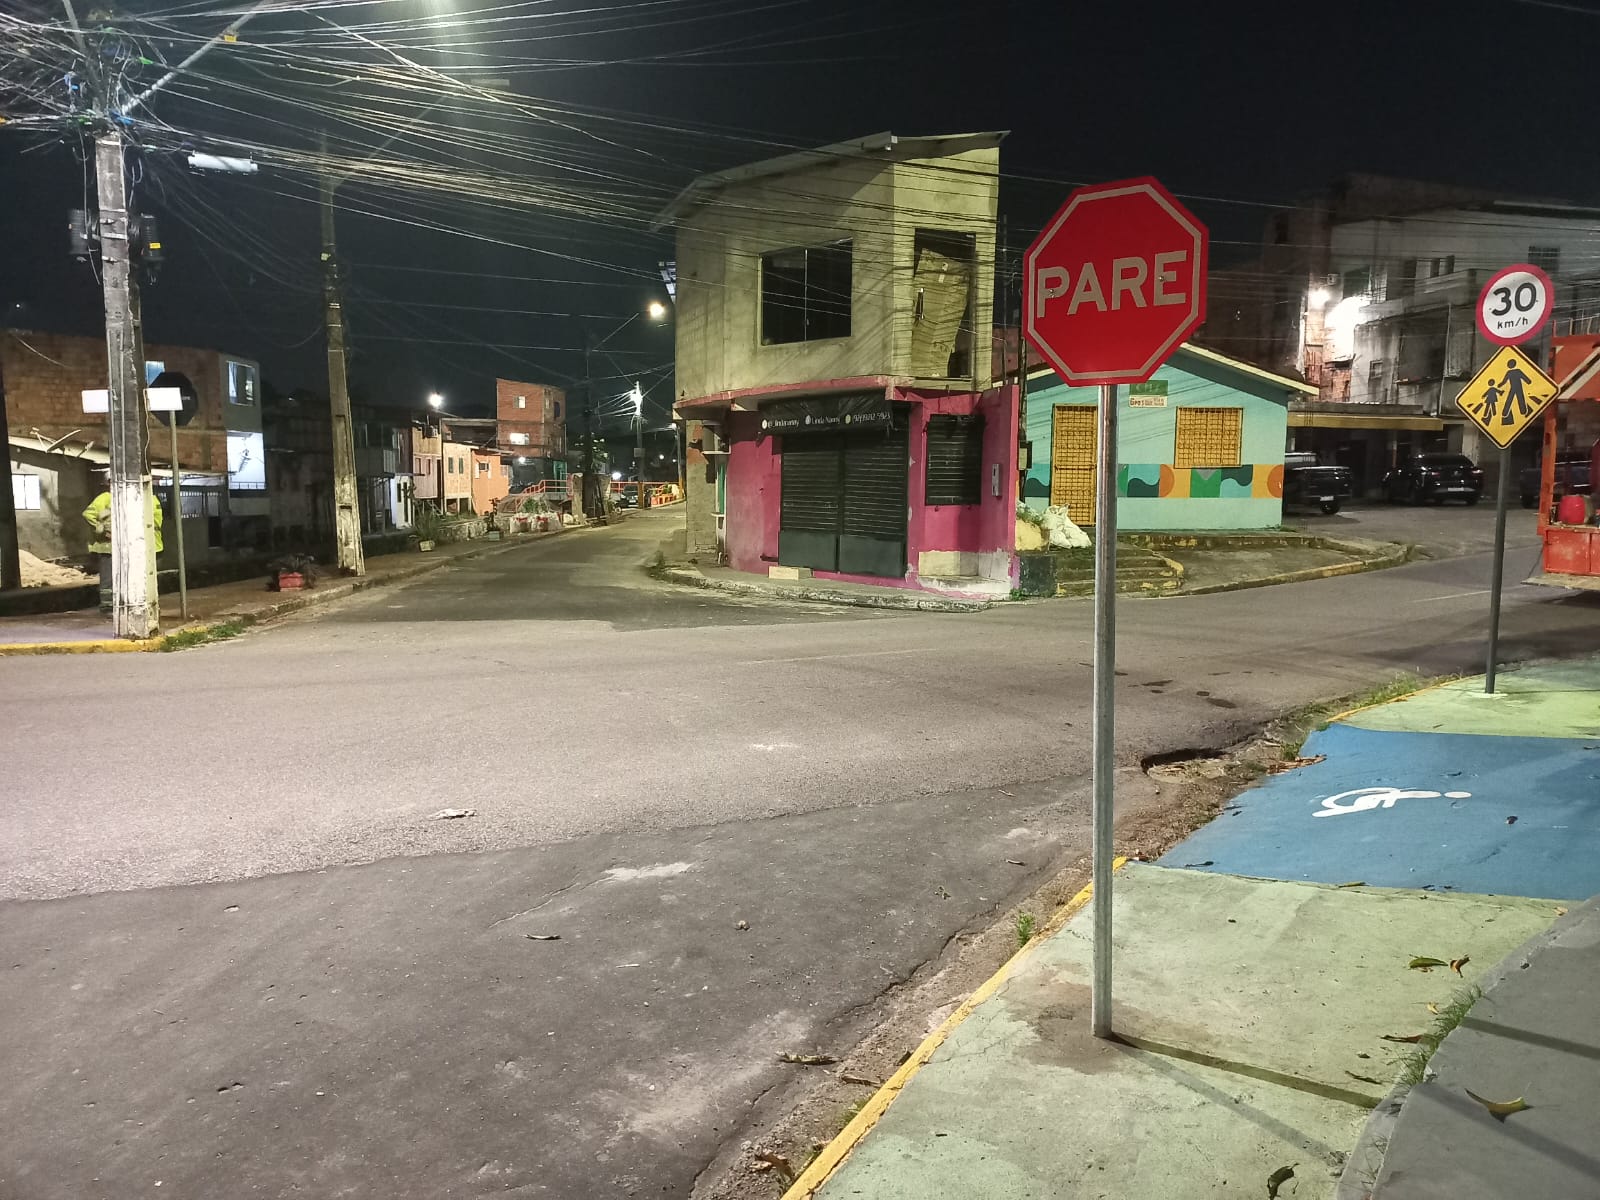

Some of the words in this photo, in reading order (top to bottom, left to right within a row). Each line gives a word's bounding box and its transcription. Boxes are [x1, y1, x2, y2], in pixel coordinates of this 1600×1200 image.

[1036, 250, 1188, 318] PARE
[1491, 282, 1537, 316] 30
[1497, 317, 1529, 329] km/h
